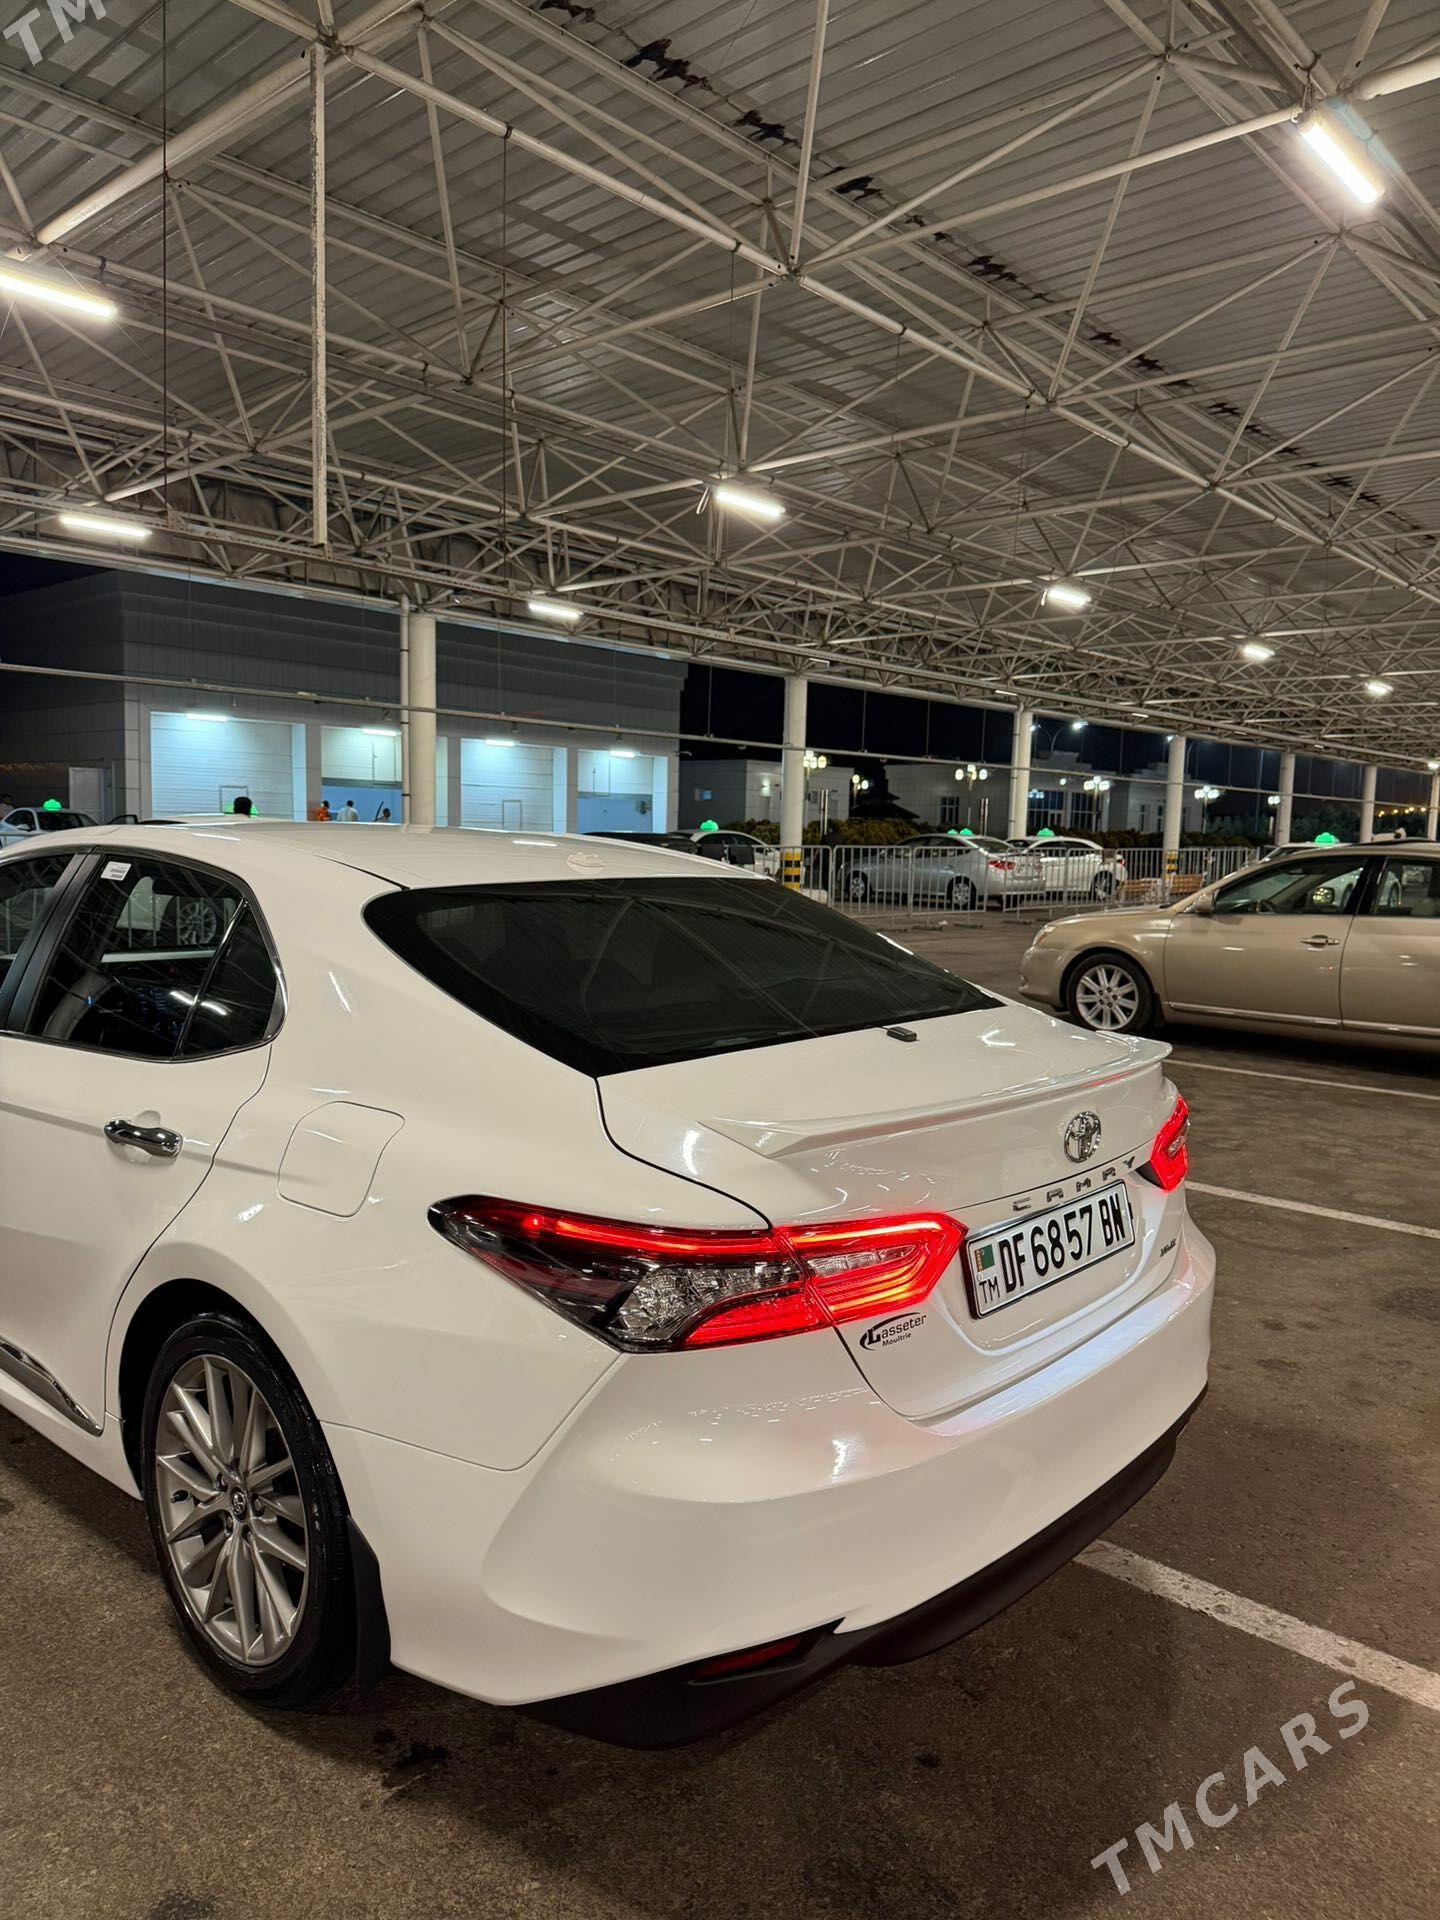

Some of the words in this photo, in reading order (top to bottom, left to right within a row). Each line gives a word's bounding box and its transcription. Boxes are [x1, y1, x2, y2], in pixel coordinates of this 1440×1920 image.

[1012, 1156, 1136, 1212] CAMRY
[1098, 1193, 1126, 1248] BN
[979, 1275, 1001, 1304] TM
[866, 1314, 927, 1345] Lasseter
[882, 1333, 912, 1347] Moultrie
